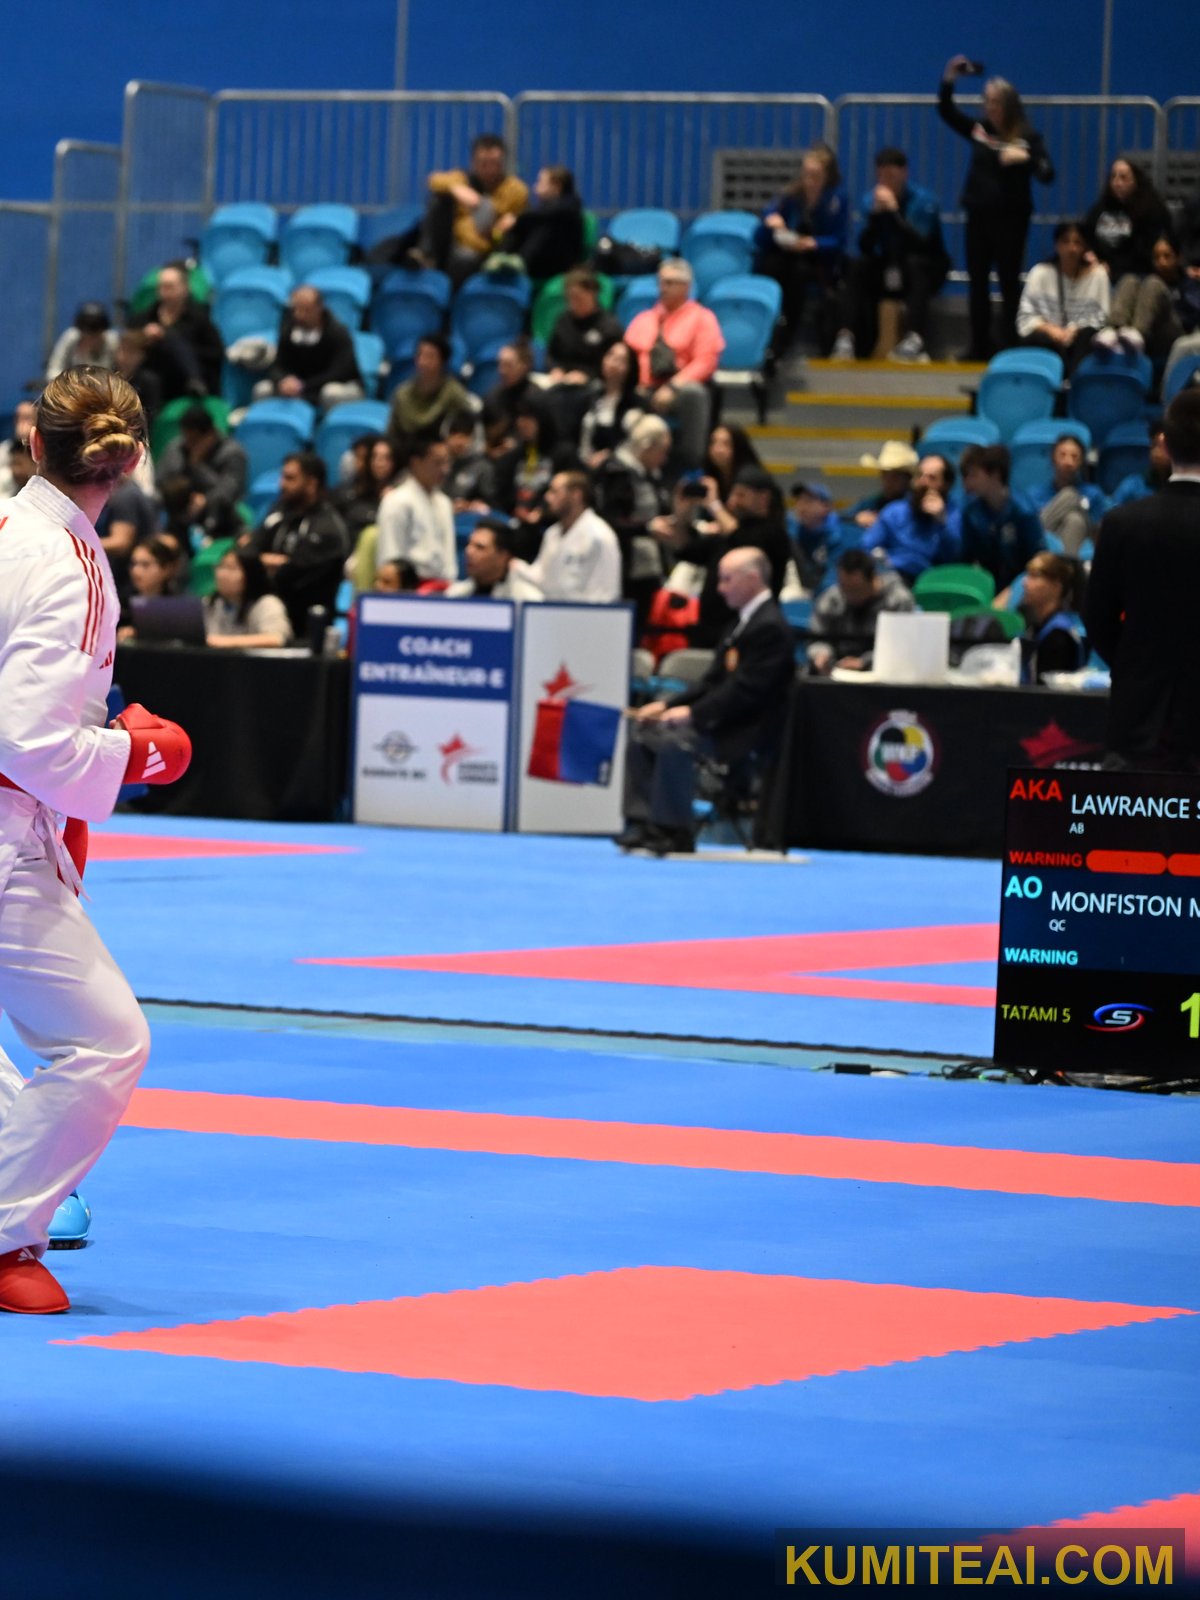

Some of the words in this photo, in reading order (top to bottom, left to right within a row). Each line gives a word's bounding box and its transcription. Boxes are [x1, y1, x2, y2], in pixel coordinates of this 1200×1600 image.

[399, 636, 473, 658] COACH
[1009, 779, 1063, 801] AKA
[1071, 794, 1190, 819] LAWRANCE
[1069, 822, 1084, 834] AB
[1009, 850, 1082, 867] WARNING
[1004, 875, 1042, 899] AO
[1051, 890, 1182, 918] MONFISTON
[1049, 919, 1066, 932] QC
[1004, 947, 1079, 966] WARNING
[1001, 1004, 1058, 1022] TATAMI
[1062, 1007, 1071, 1024] 5
[1181, 992, 1200, 1038] 1
